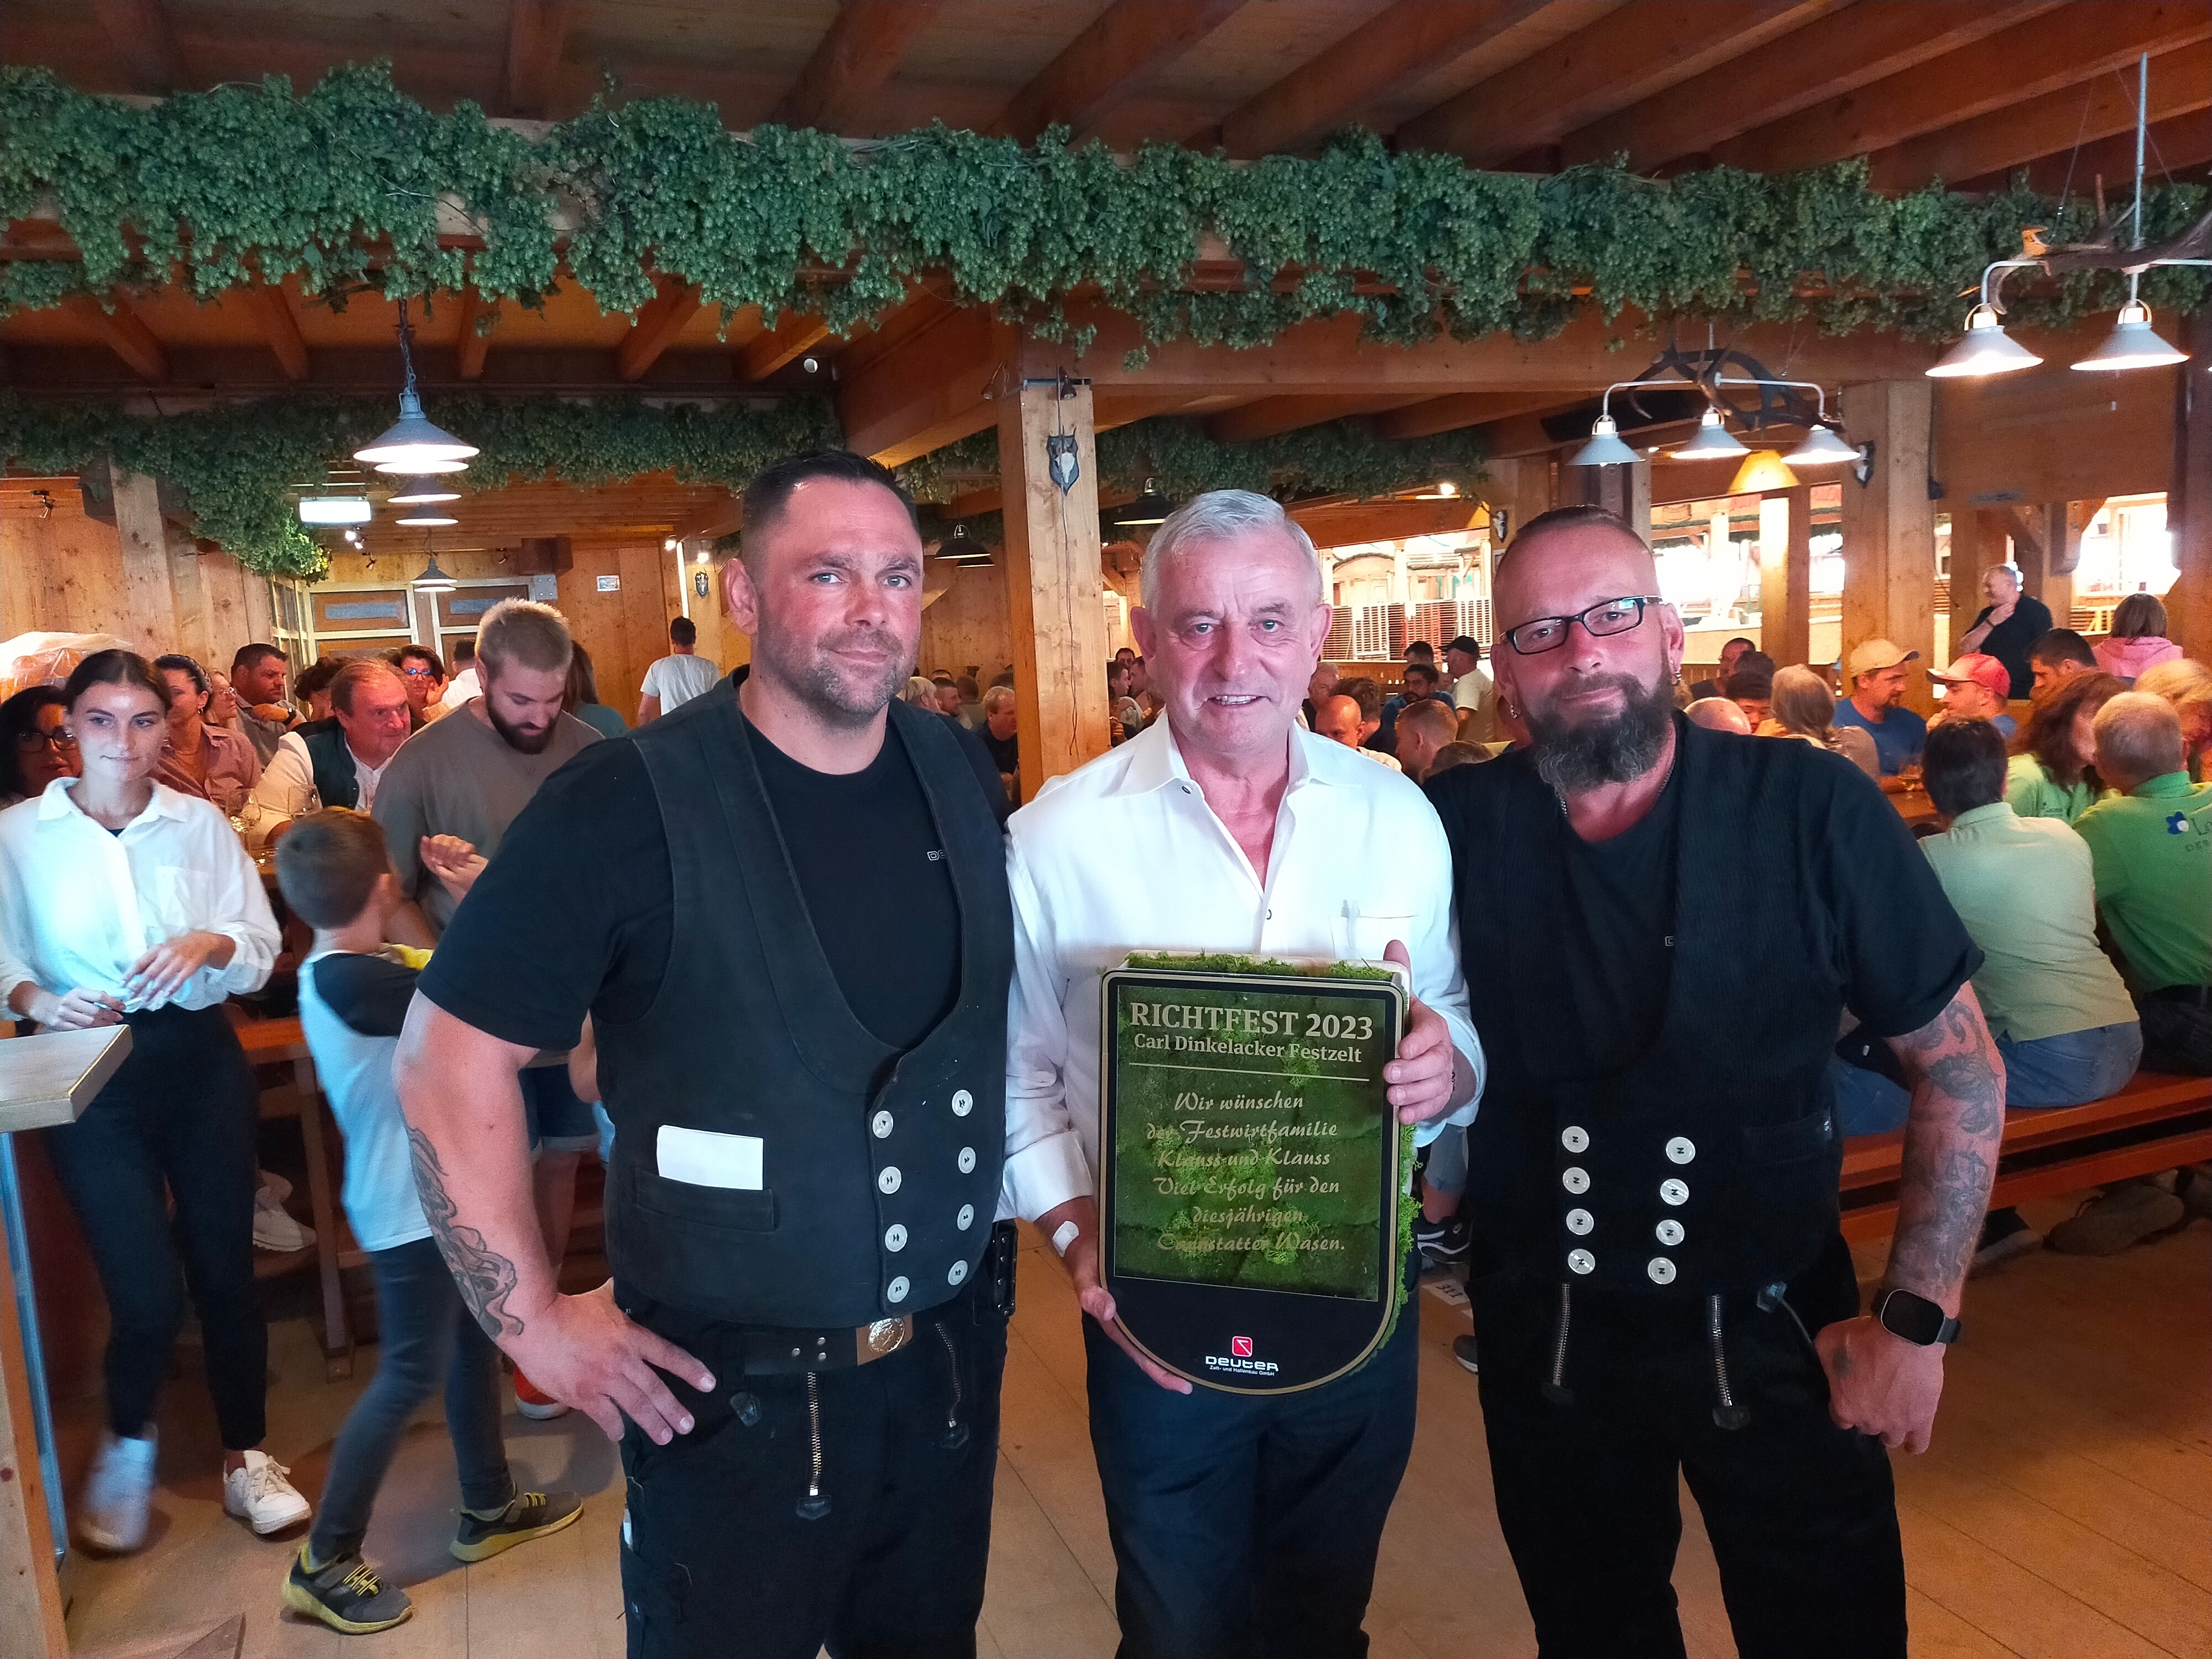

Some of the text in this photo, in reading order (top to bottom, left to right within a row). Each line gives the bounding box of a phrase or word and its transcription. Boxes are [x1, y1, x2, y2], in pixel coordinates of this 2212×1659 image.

[1130, 1002, 1373, 1040] RICHTFEST 2023
[1134, 1033, 1362, 1063] Carl Dinkelacker Festzelt
[1174, 1090, 1303, 1111] Wir wünschen
[1180, 1119, 1338, 1144] Festwirtfamilie
[1267, 1147, 1331, 1166] Klauss
[1152, 1176, 1339, 1201] Viel Erfolg für den
[1193, 1204, 1303, 1229] diesjährigen
[1272, 1232, 1345, 1251] Wasen.
